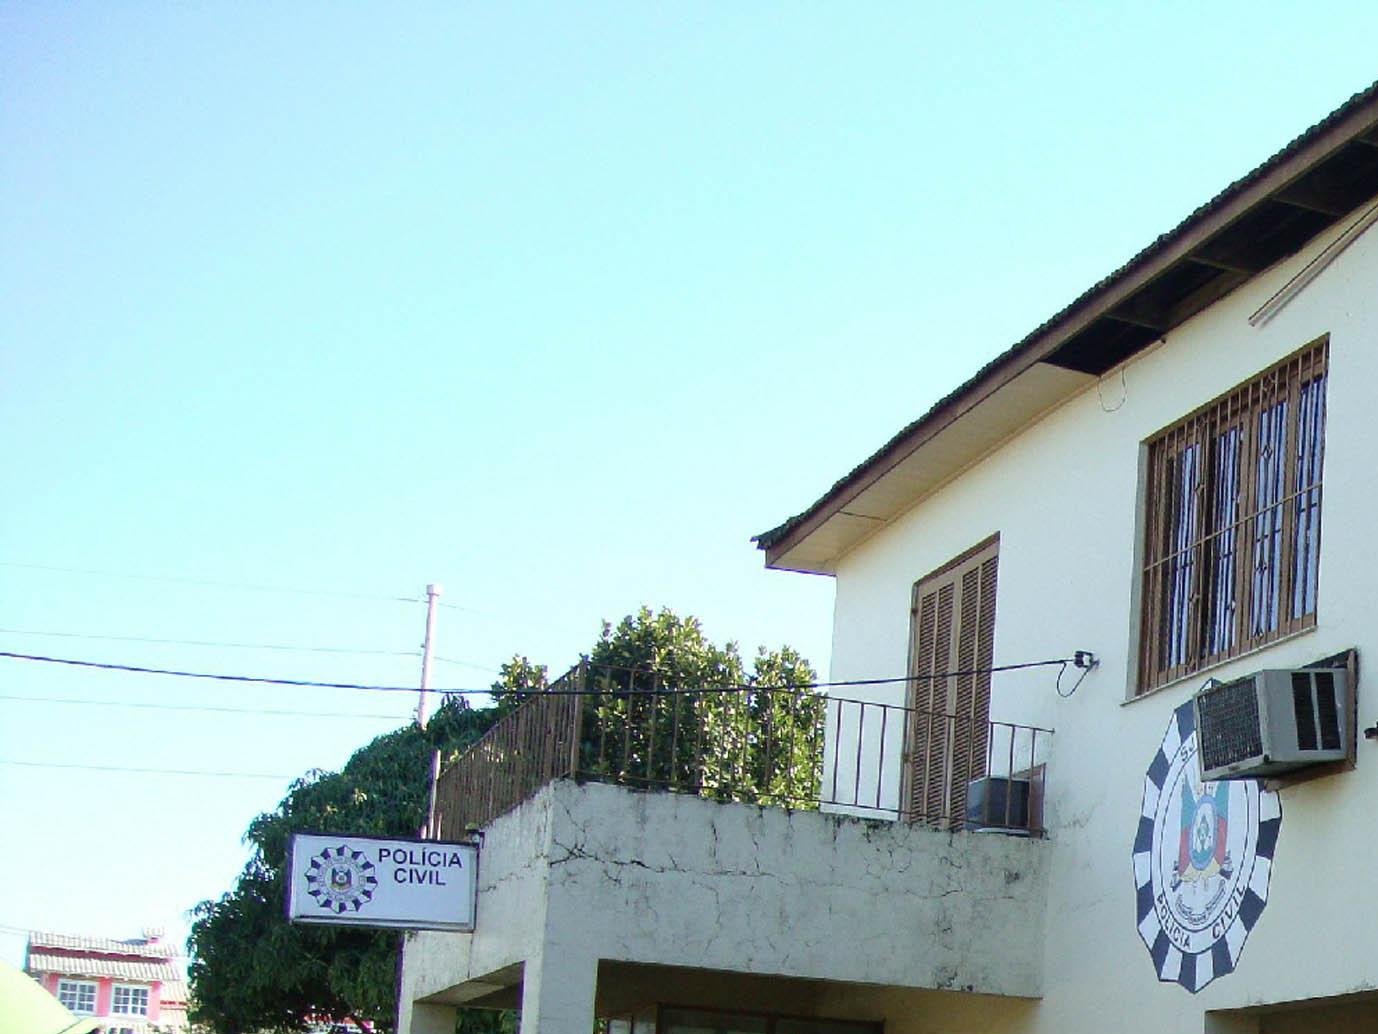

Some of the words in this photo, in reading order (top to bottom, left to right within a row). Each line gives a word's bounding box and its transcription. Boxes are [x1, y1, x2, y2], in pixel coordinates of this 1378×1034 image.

[378, 847, 463, 868] POLÍCIA
[393, 867, 447, 886] CIVIL
[1211, 885, 1246, 940] CIVIL
